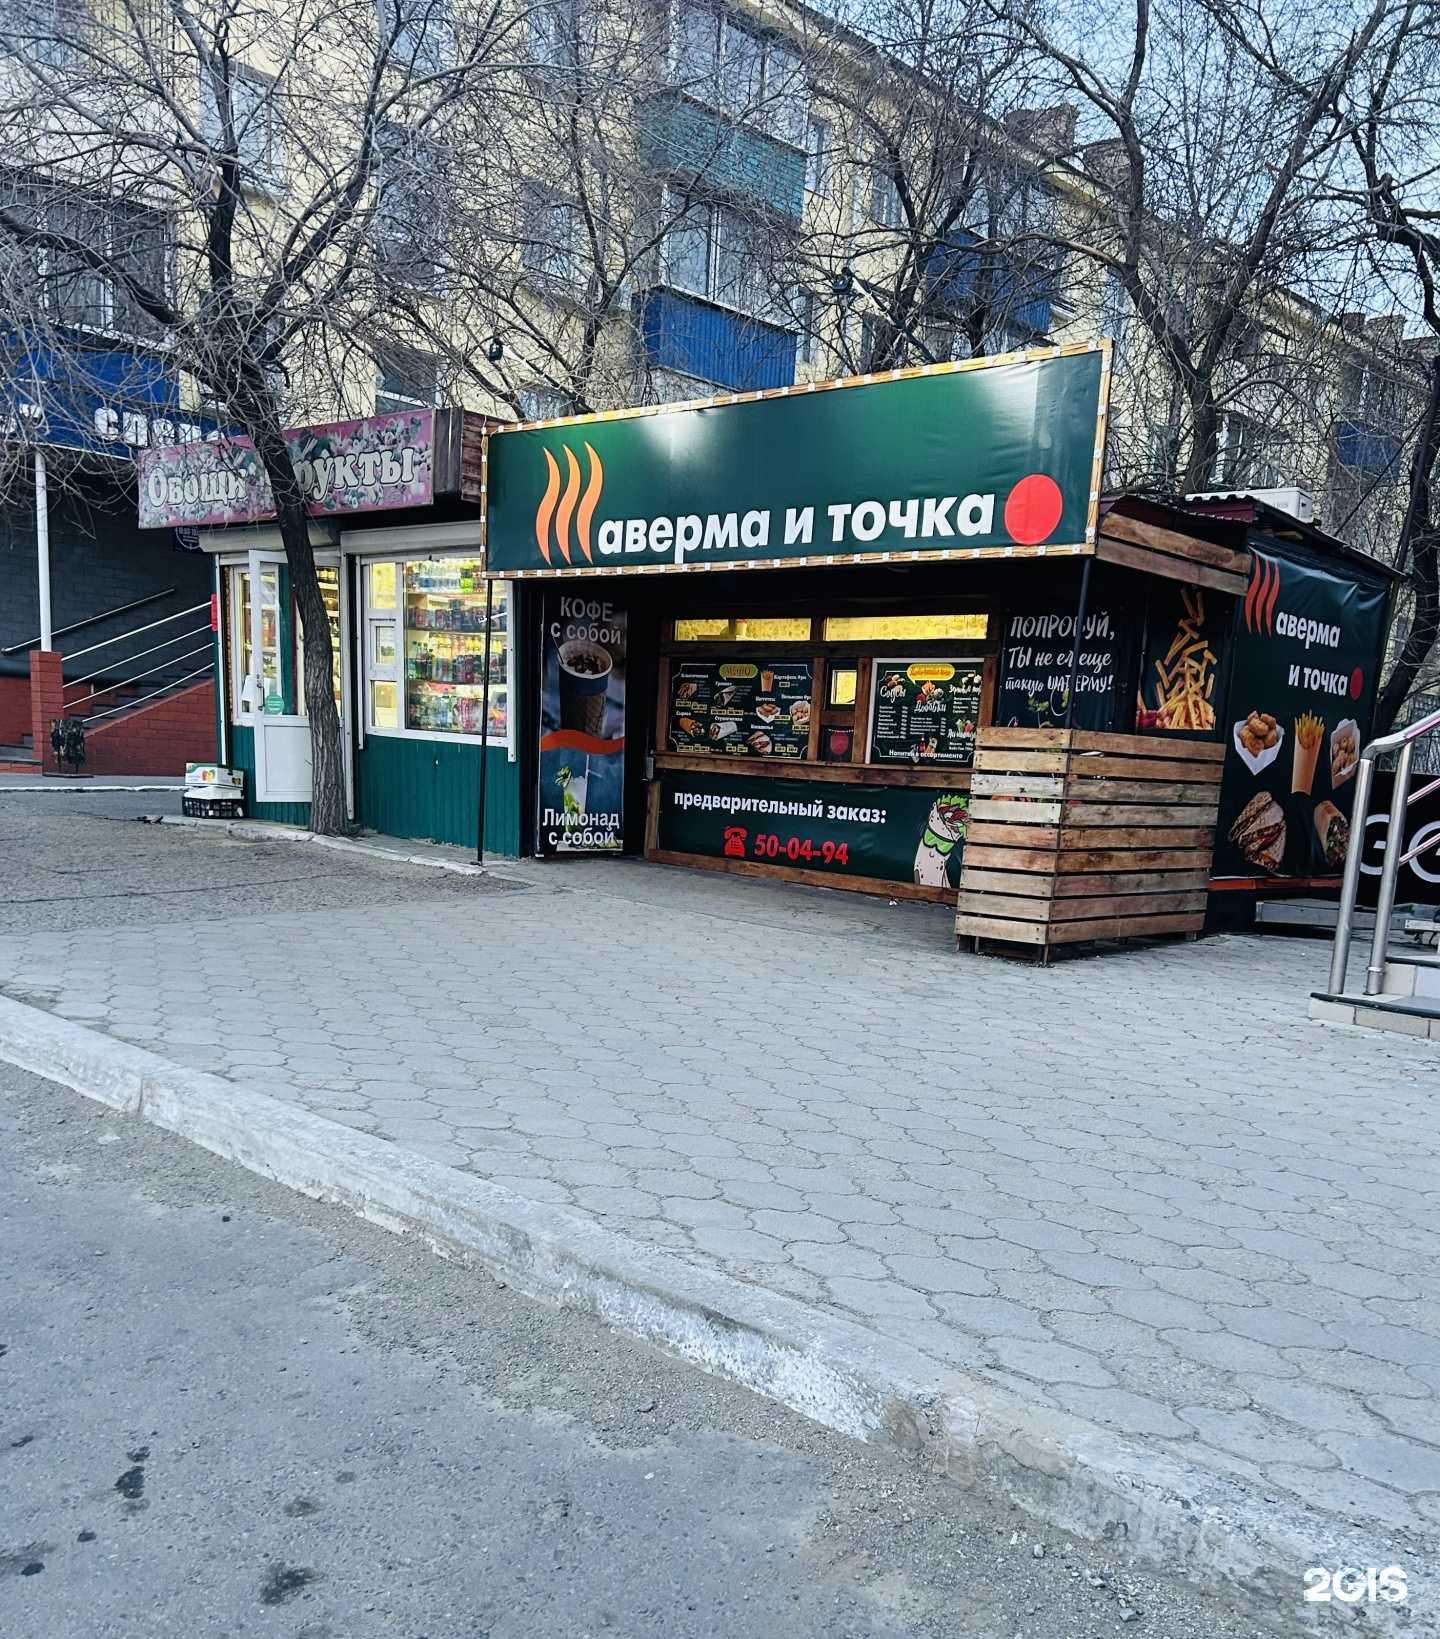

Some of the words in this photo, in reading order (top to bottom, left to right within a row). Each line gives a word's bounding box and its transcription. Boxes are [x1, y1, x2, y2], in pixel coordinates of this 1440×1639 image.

[149, 467, 248, 506] Овощи
[282, 447, 415, 501] рукты
[783, 506, 815, 546] и
[827, 493, 996, 542] точка
[560, 596, 613, 622] КОФЕ
[566, 622, 621, 645] собой
[1008, 646, 1032, 669] ТЫ
[1034, 652, 1053, 667] не
[1079, 653, 1113, 673] еще
[1005, 676, 1045, 697] такую
[1288, 664, 1300, 687] и
[1303, 668, 1348, 696] точка
[542, 808, 620, 829] Лимонад
[674, 791, 824, 818] предварительный
[826, 805, 887, 824] заказ:
[562, 827, 614, 846] собой
[754, 834, 849, 865] 50-04-94
